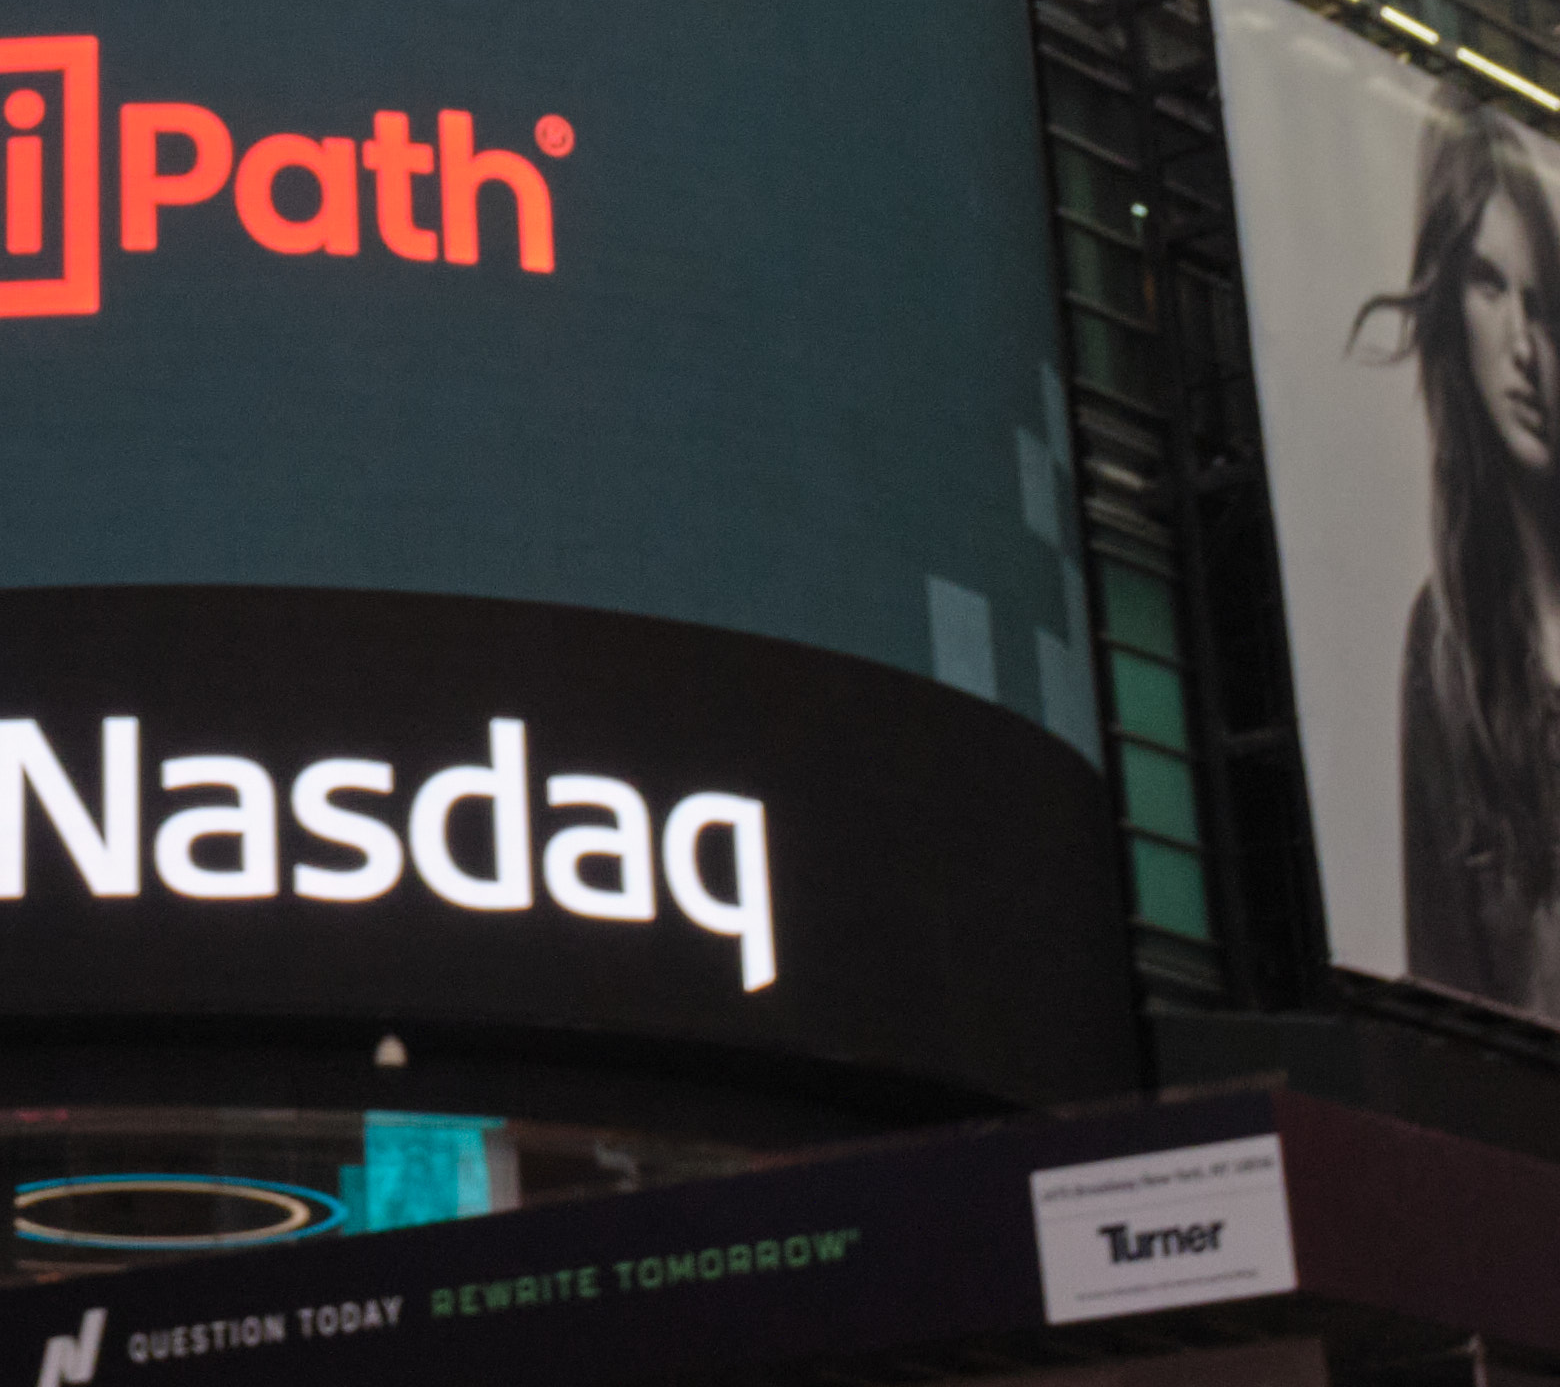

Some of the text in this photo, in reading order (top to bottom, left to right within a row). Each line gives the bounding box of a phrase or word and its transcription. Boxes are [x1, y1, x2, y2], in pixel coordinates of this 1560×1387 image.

[1097, 1219, 1225, 1265] Turner
[126, 1313, 287, 1365] QUESTION
[297, 1295, 406, 1339] TODAY
[430, 1265, 603, 1319] REWRITE
